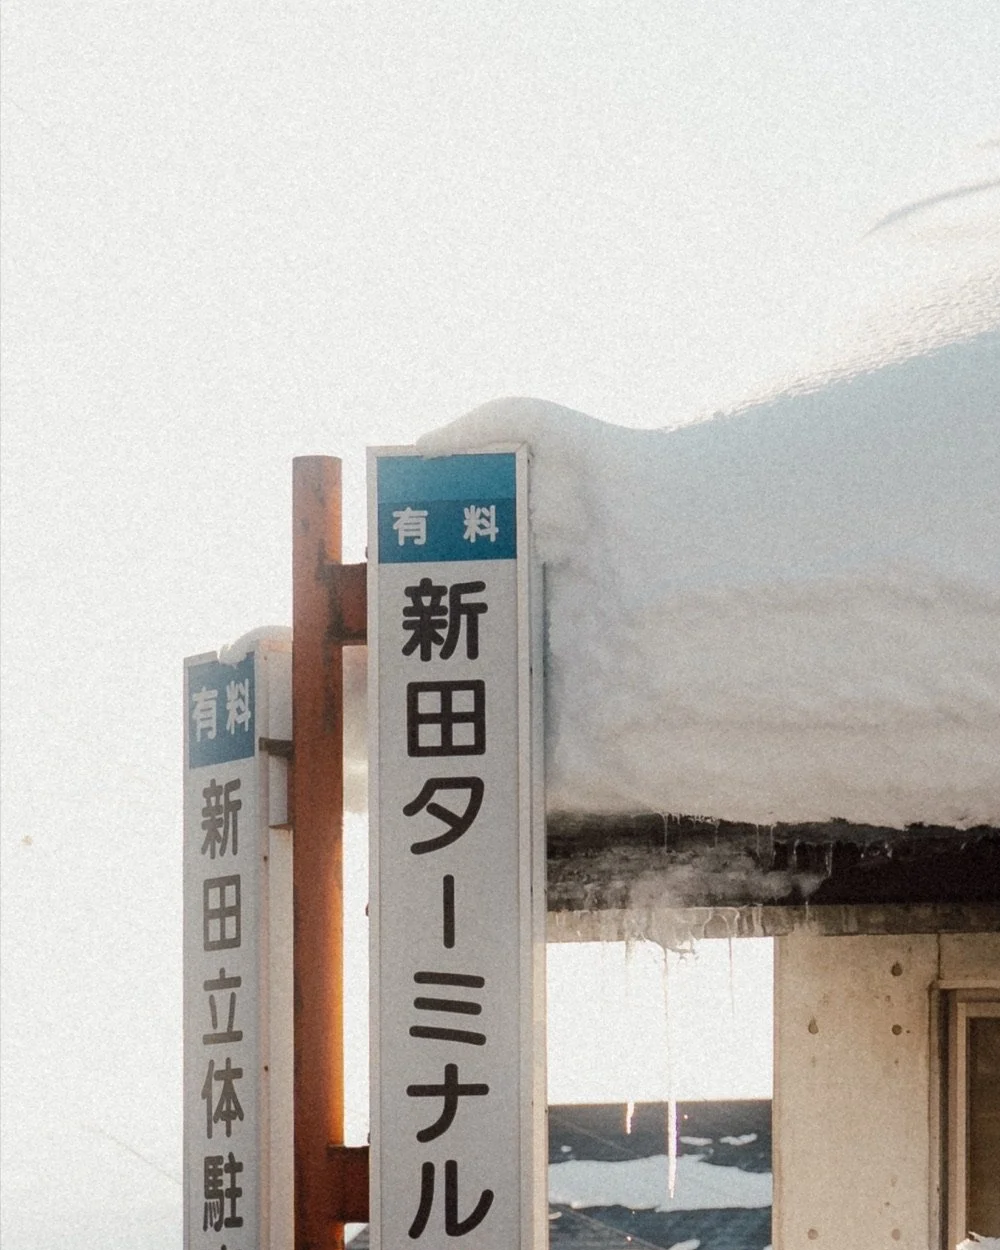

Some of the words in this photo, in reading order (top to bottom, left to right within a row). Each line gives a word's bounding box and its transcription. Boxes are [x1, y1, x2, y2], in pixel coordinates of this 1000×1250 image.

[392, 504, 499, 546] 有料
[191, 678, 252, 743] 有料
[402, 577, 495, 1240] 新田ターミナル
